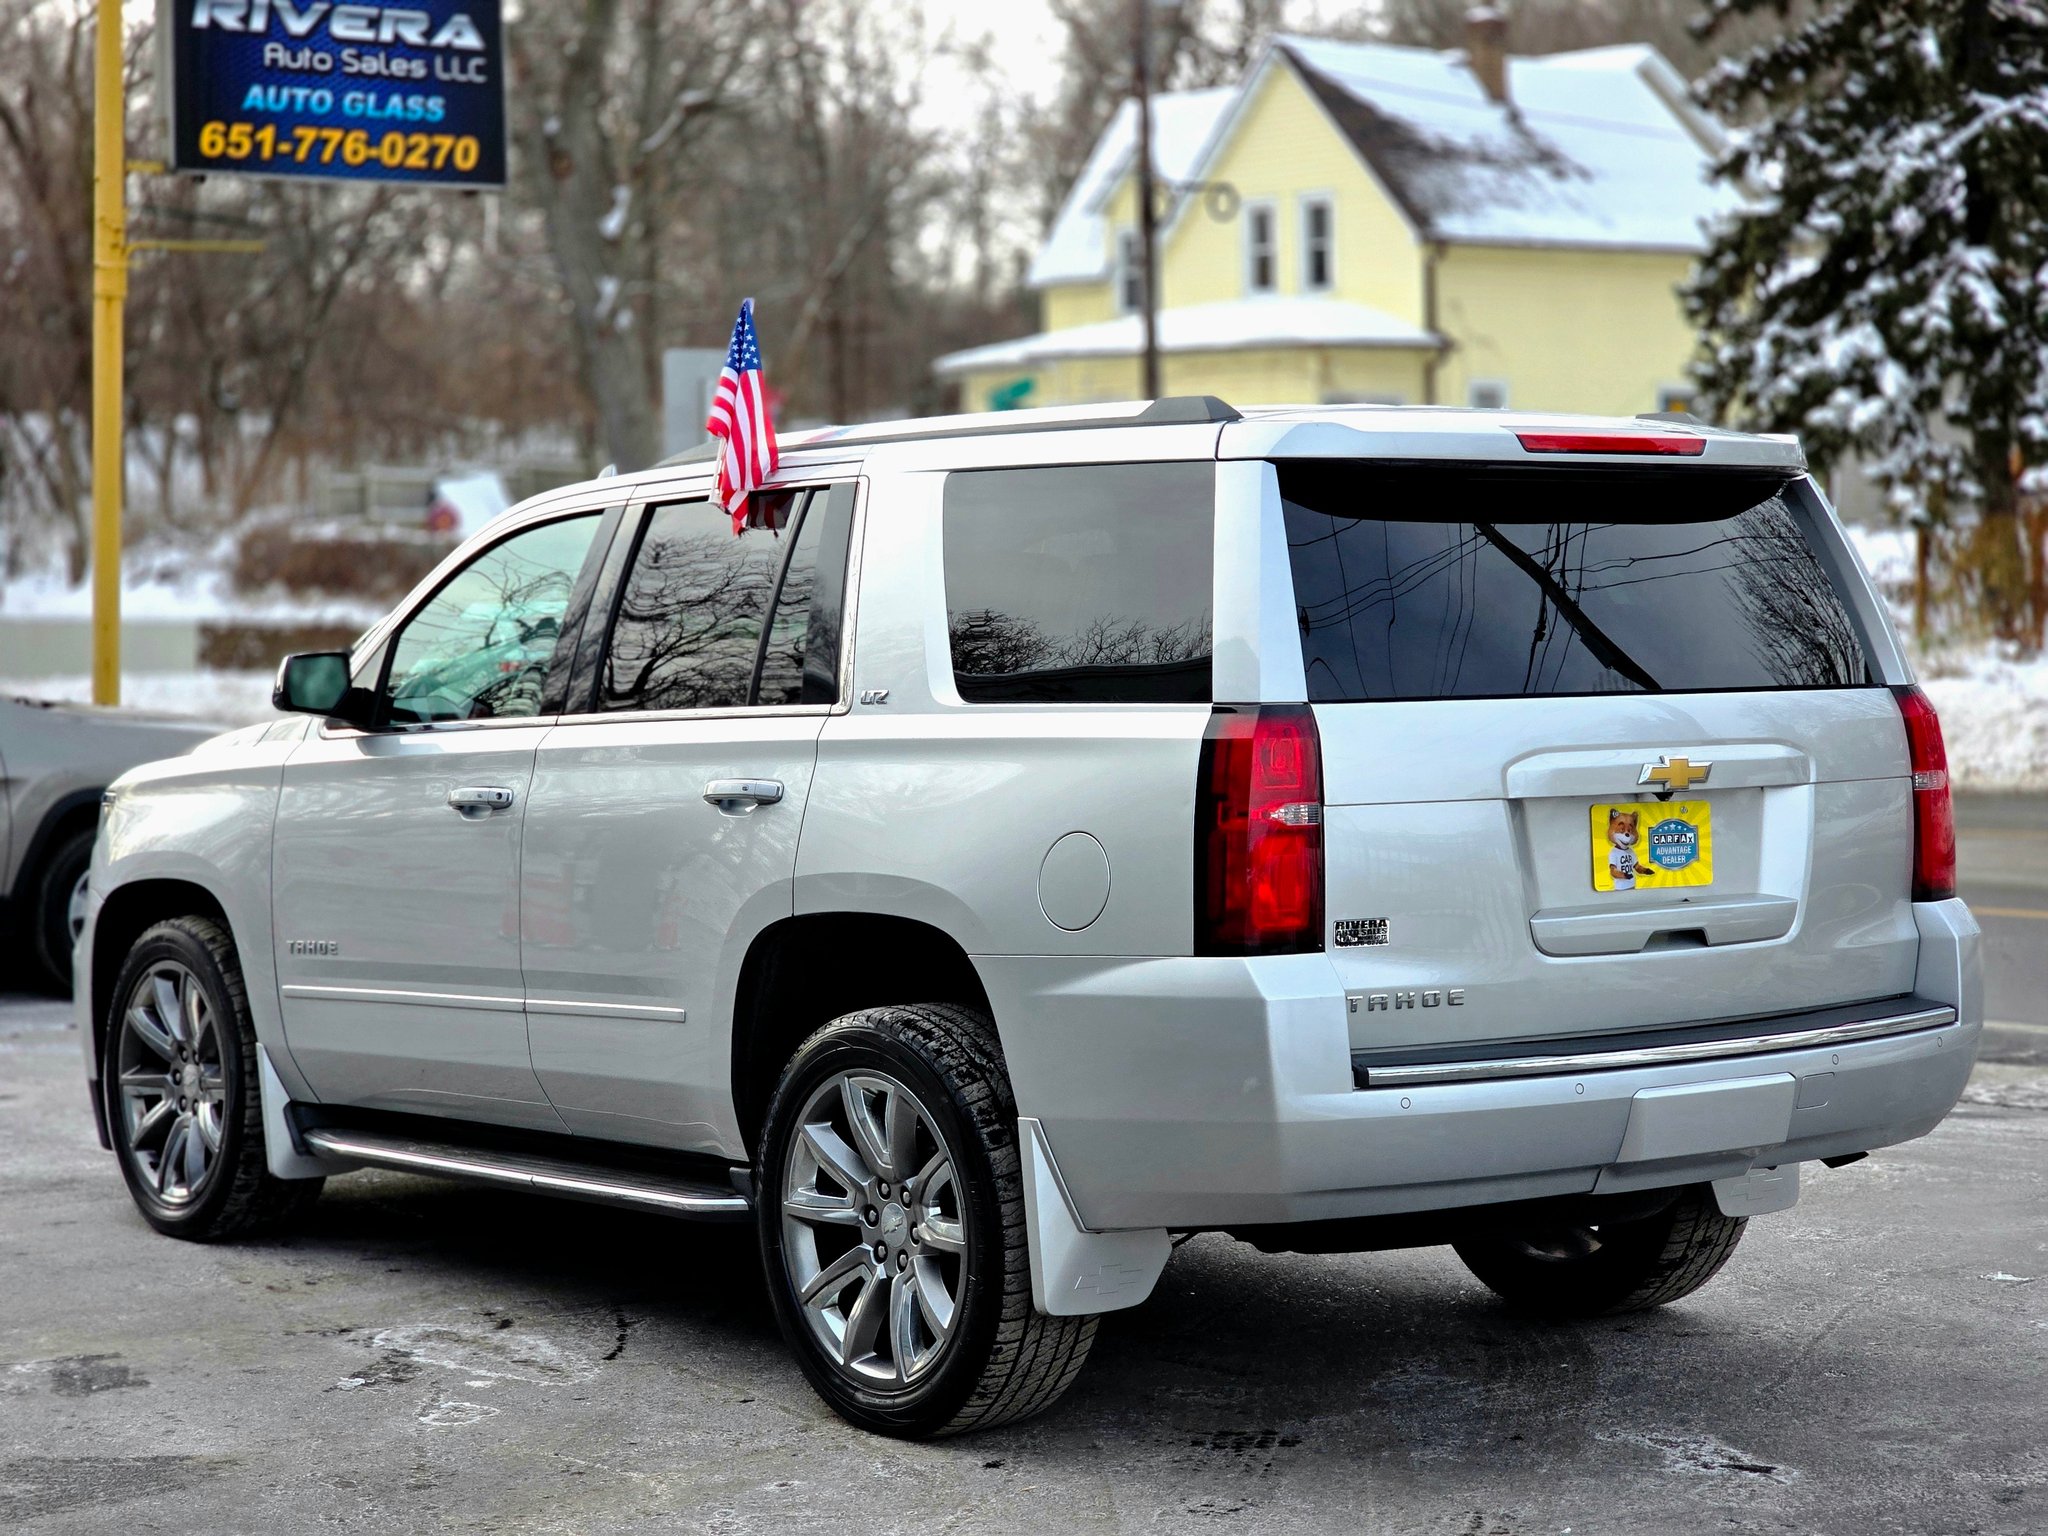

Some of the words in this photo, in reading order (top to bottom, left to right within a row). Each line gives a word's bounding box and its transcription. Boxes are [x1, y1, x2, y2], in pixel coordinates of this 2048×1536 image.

[191, 0, 486, 50] RIVERA
[263, 42, 334, 72] Auto
[341, 48, 428, 78] Sales
[434, 54, 489, 84] LLC
[242, 84, 333, 115] AUTO
[342, 92, 447, 123] GLASS
[199, 120, 481, 173] 651-776-0270
[1653, 832, 1694, 845] CARFAX
[1656, 846, 1692, 856] ADVANTAGE
[1620, 855, 1632, 864] CAR
[1662, 856, 1686, 864] DEALER
[1335, 919, 1387, 930] RIVERA
[286, 940, 339, 955] TAHOE
[1346, 988, 1465, 1013] TAHOE
